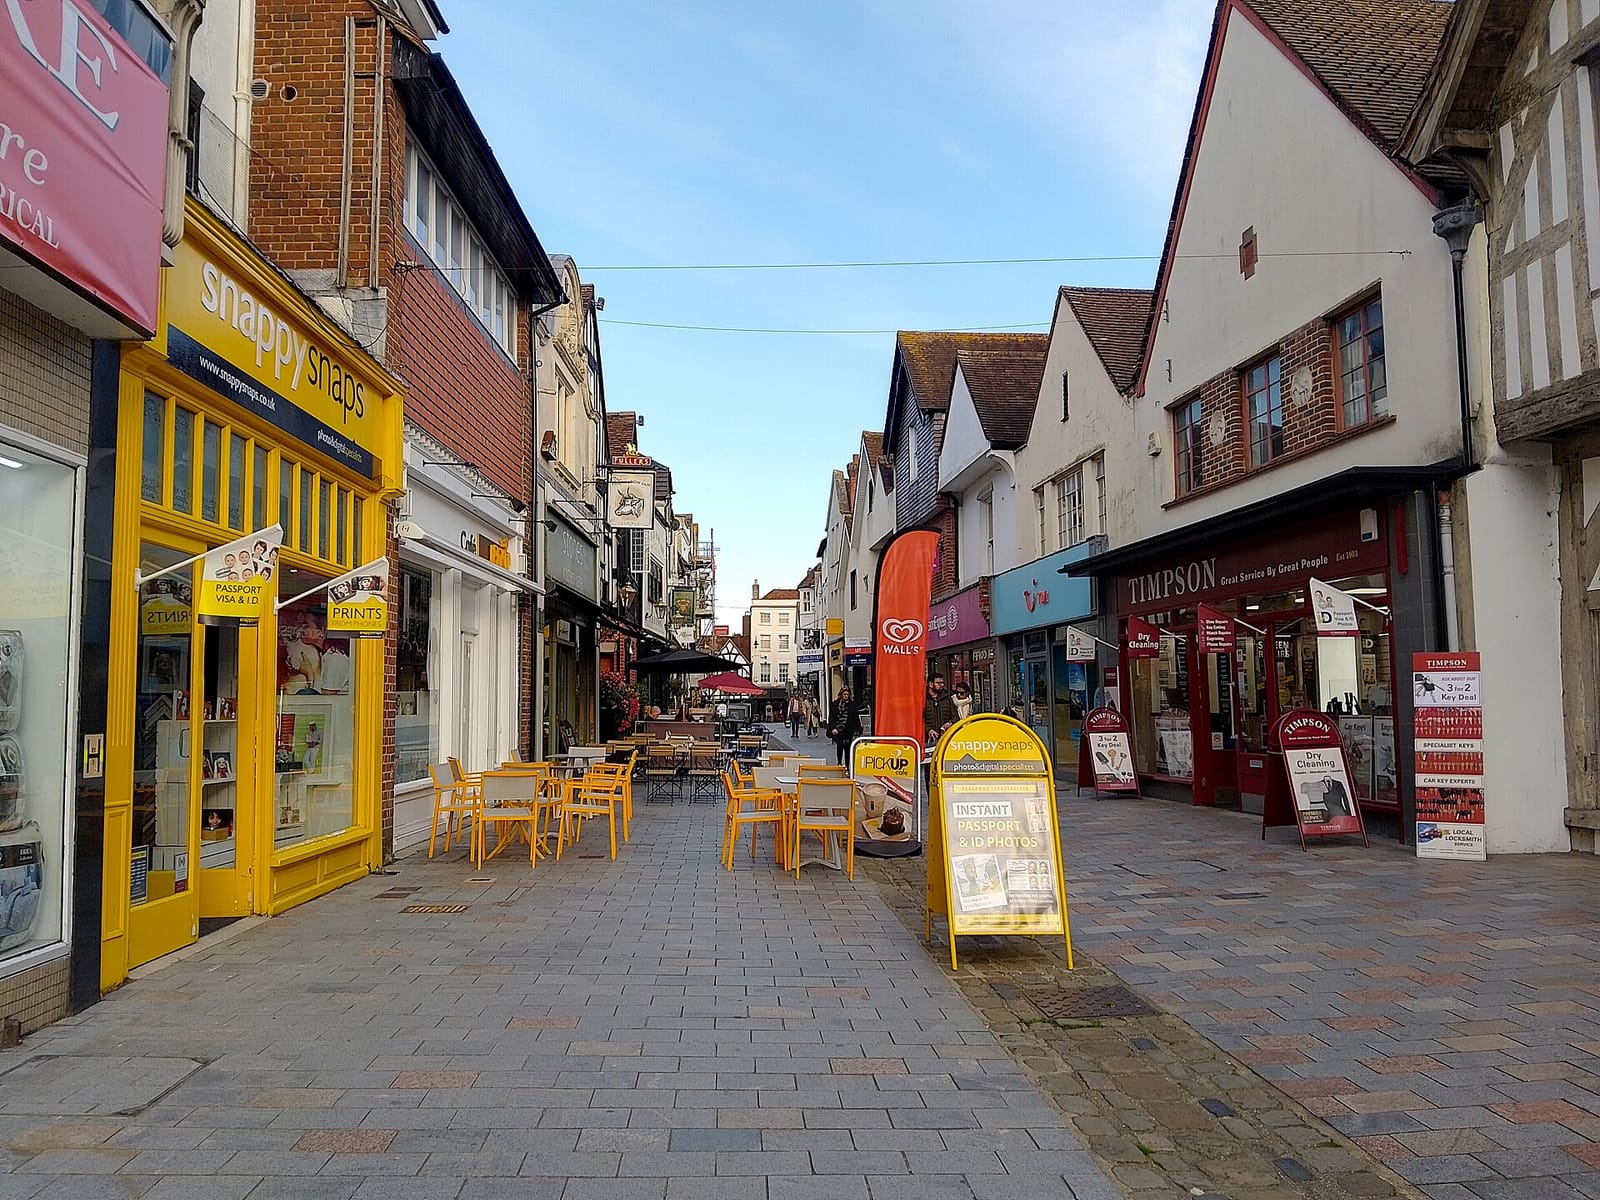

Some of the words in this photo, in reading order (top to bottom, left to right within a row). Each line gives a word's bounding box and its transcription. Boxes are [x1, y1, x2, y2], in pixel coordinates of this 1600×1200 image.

[199, 355, 276, 412] www.snappysnaps.co.uk
[1128, 557, 1216, 604] TIMPSON
[1220, 575, 1238, 586] Great
[1239, 569, 1265, 583] Service
[1266, 566, 1276, 578] By
[1278, 561, 1300, 575] Great
[1301, 555, 1329, 570] People
[215, 584, 262, 594] PASSPORT
[216, 594, 236, 604] VISA
[238, 595, 244, 604] &
[332, 607, 382, 620] PRINTS
[1138, 632, 1150, 641] Dry
[883, 644, 919, 654] WALL'S
[1128, 640, 1158, 650] Cleaning
[1464, 684, 1471, 692] 2
[1090, 712, 1121, 724] TIMPSON
[1284, 718, 1331, 735] TIMPSON
[1306, 752, 1321, 760] Dry
[1297, 760, 1335, 768] Cleaning
[956, 804, 1009, 816] INSTANT
[958, 820, 1021, 832] PASSPORT
[959, 838, 968, 848] &
[971, 838, 984, 847] ID
[987, 837, 1038, 848] PHOTOS
